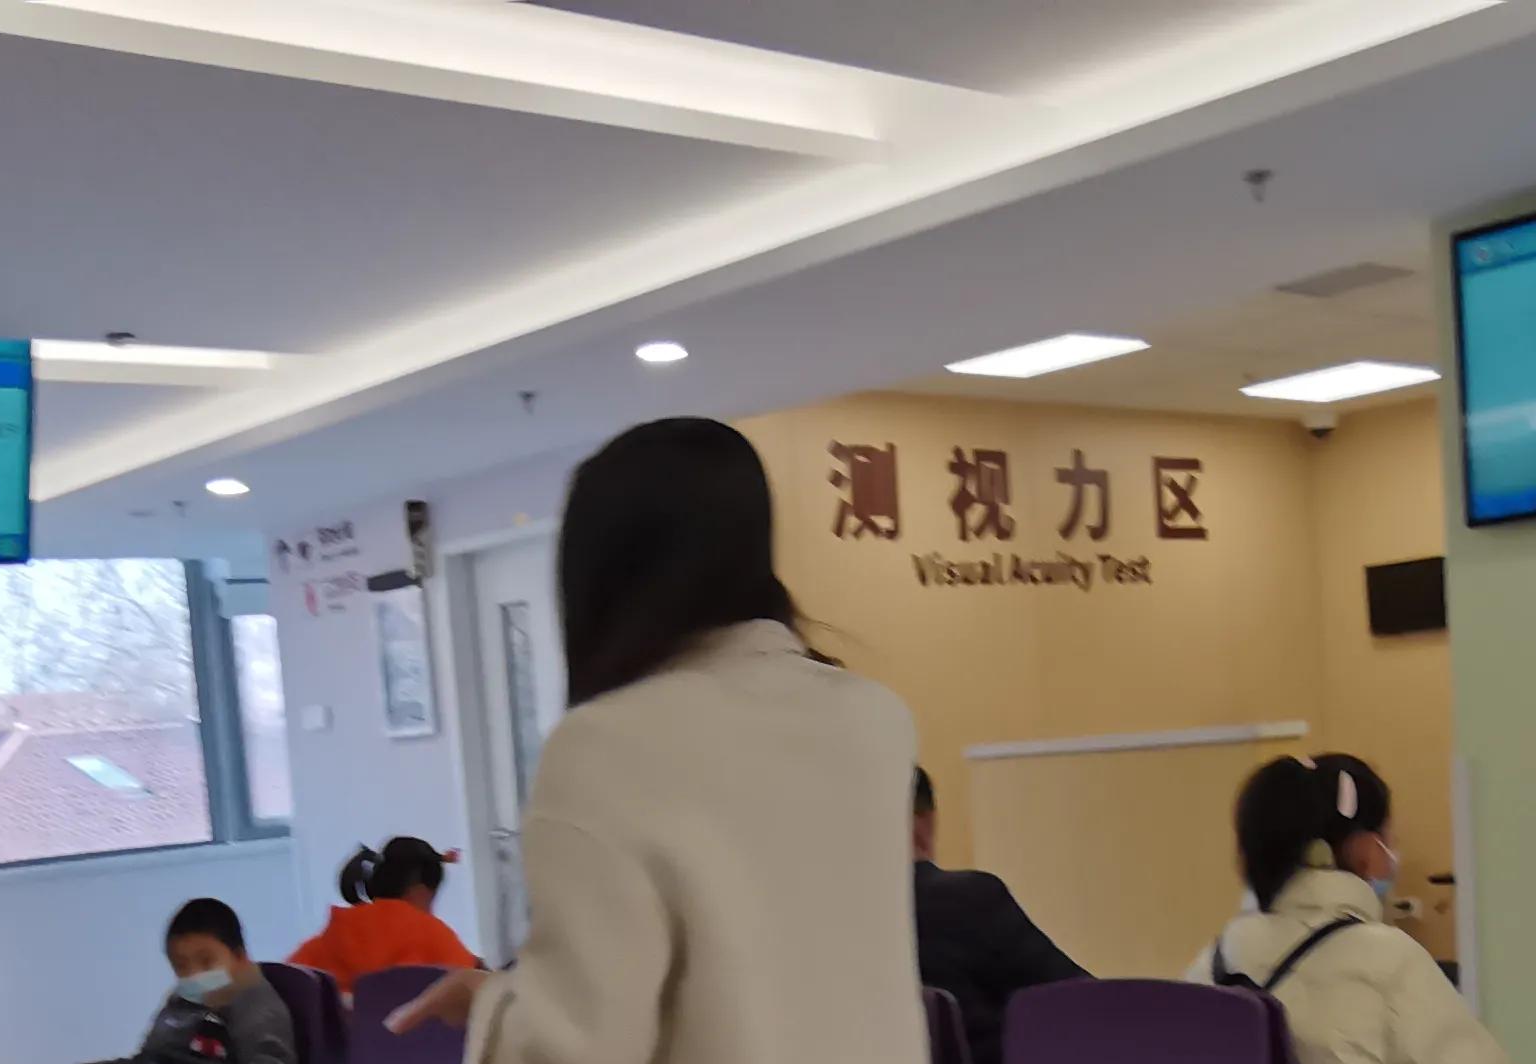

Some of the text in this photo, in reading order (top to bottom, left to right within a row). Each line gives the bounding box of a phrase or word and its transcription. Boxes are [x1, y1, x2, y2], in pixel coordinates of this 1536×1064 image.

[828, 439, 1208, 541] 测视力区
[911, 551, 1154, 592] Visual Acuity Test
